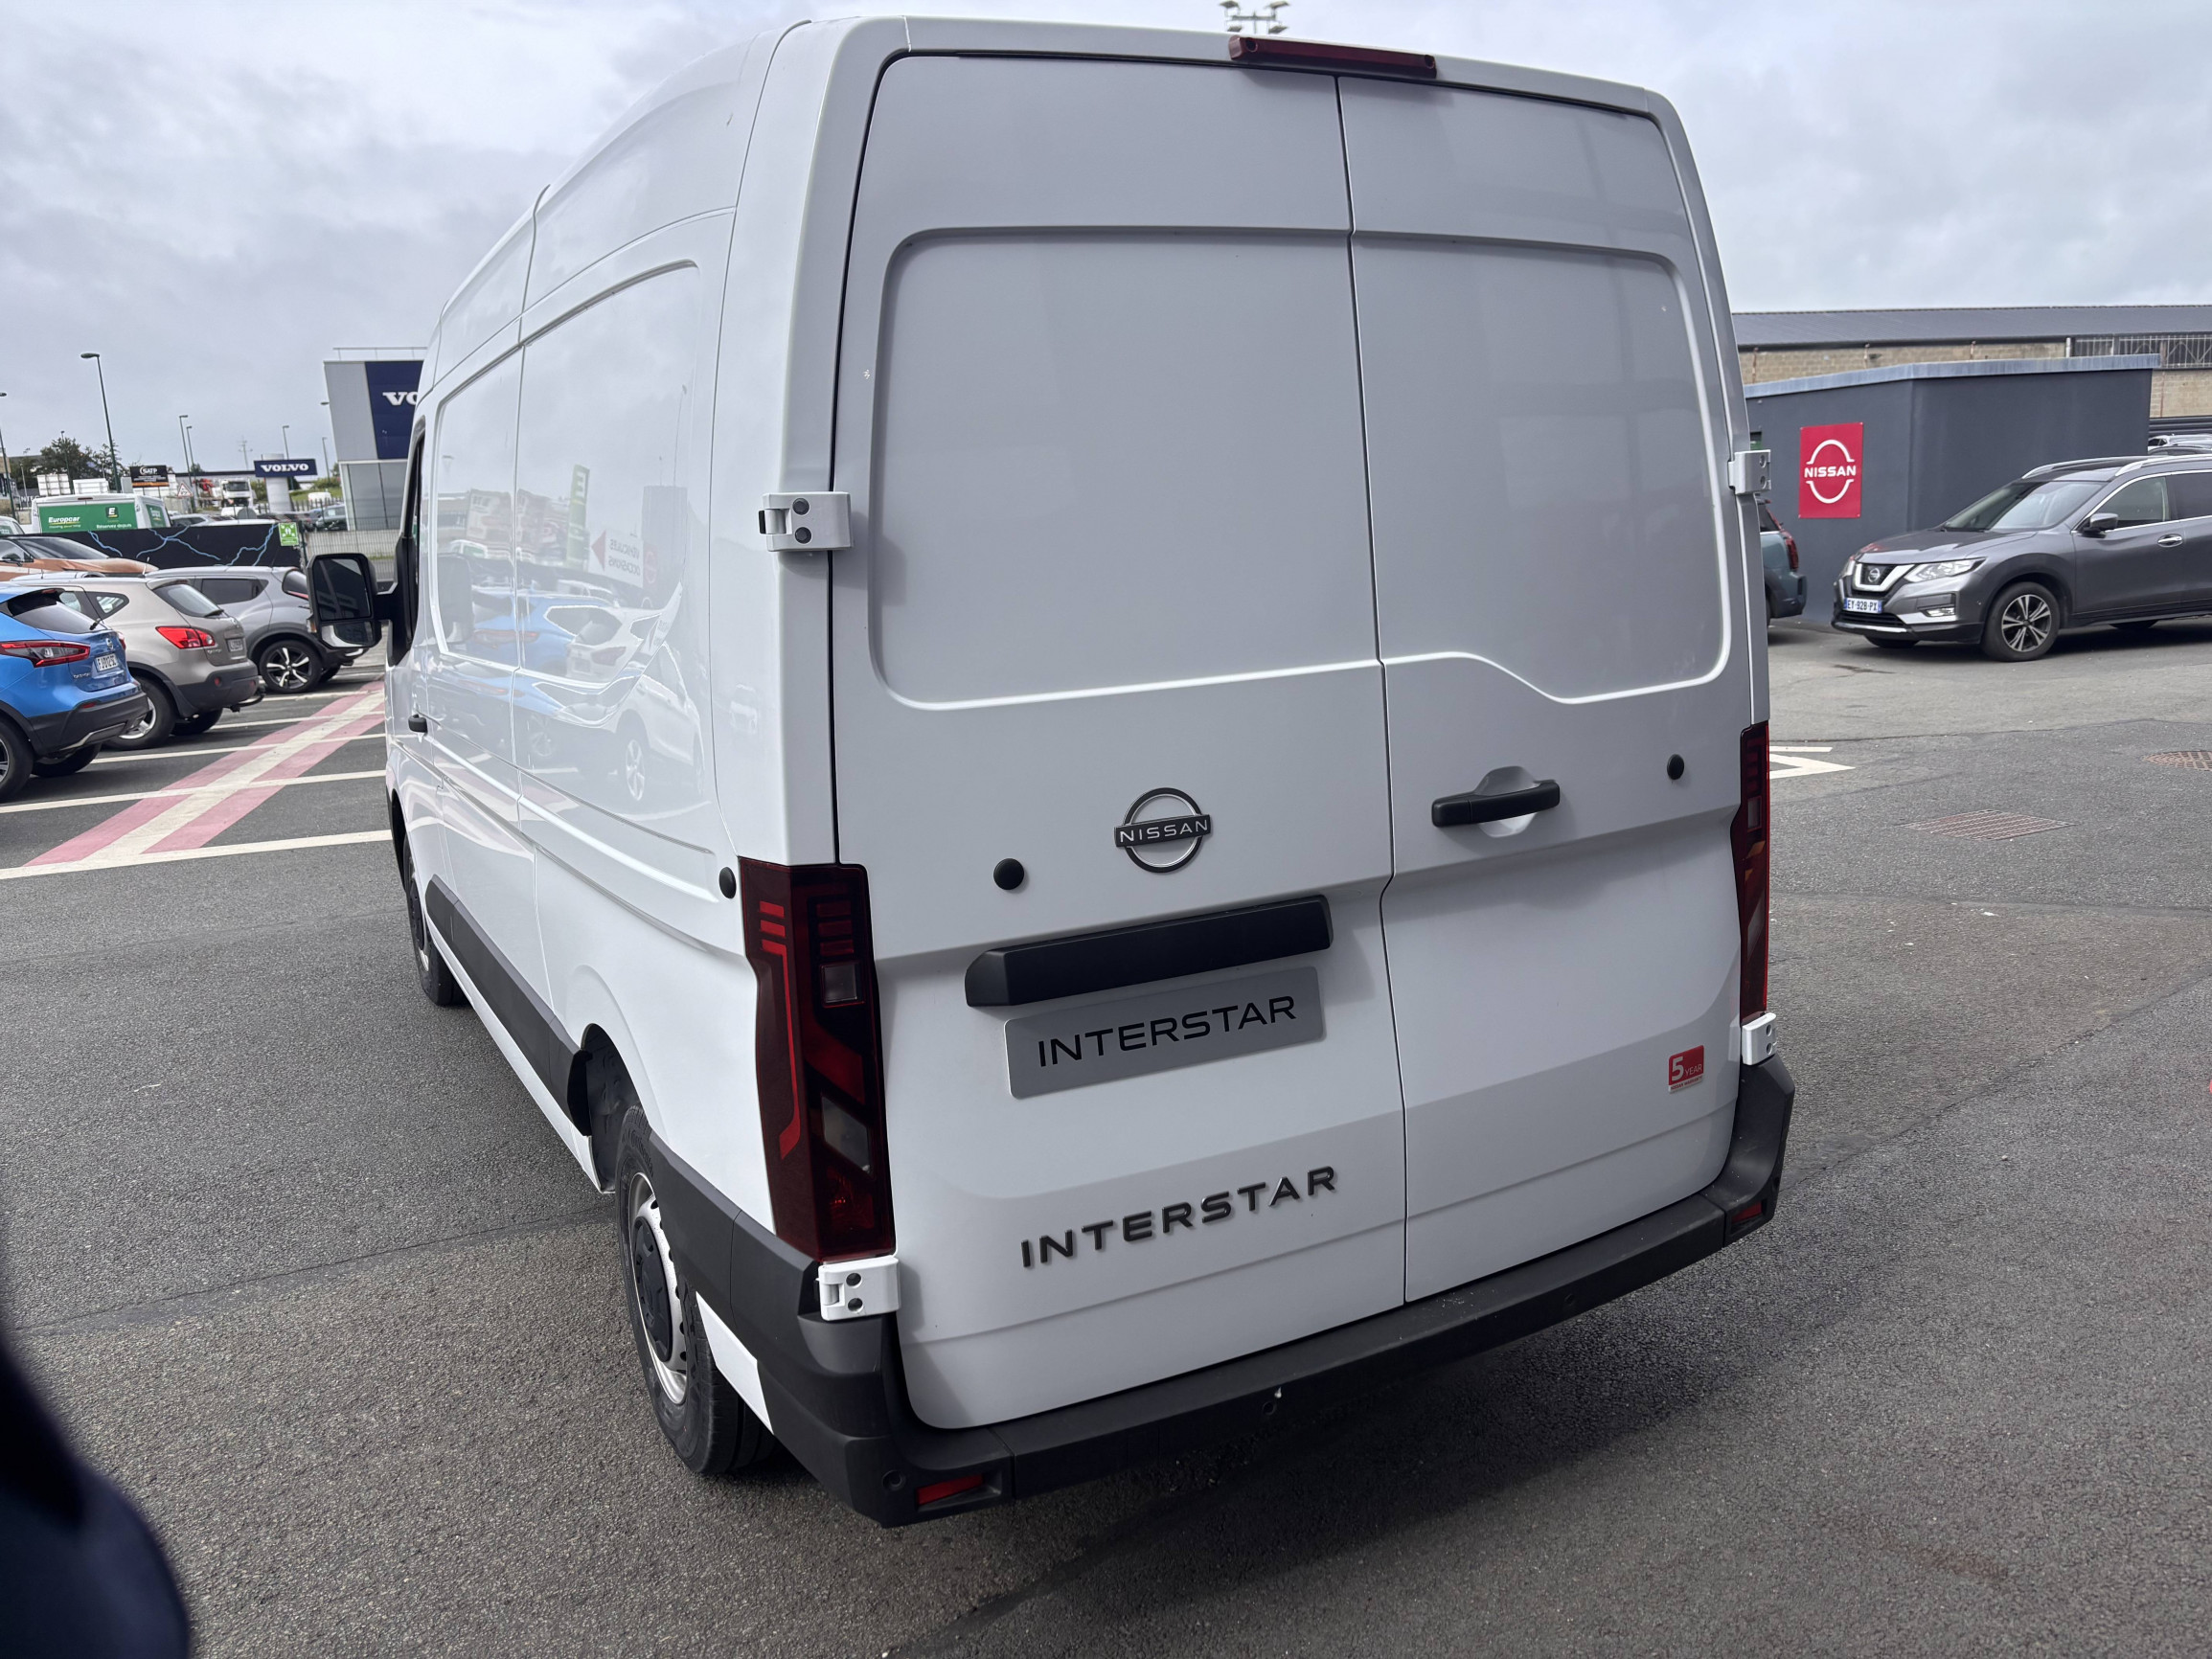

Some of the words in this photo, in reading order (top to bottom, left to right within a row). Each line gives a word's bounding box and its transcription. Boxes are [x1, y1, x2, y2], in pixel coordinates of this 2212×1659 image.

[260, 463, 309, 472] VOLVO
[1804, 466, 1857, 478] NISSAN
[1120, 820, 1208, 843] NISSAN
[1038, 995, 1297, 1068] INTERSTAR
[1671, 1056, 1684, 1081] 5
[1684, 1064, 1702, 1077] YEAR
[1020, 1166, 1336, 1268] INTERSTAR
